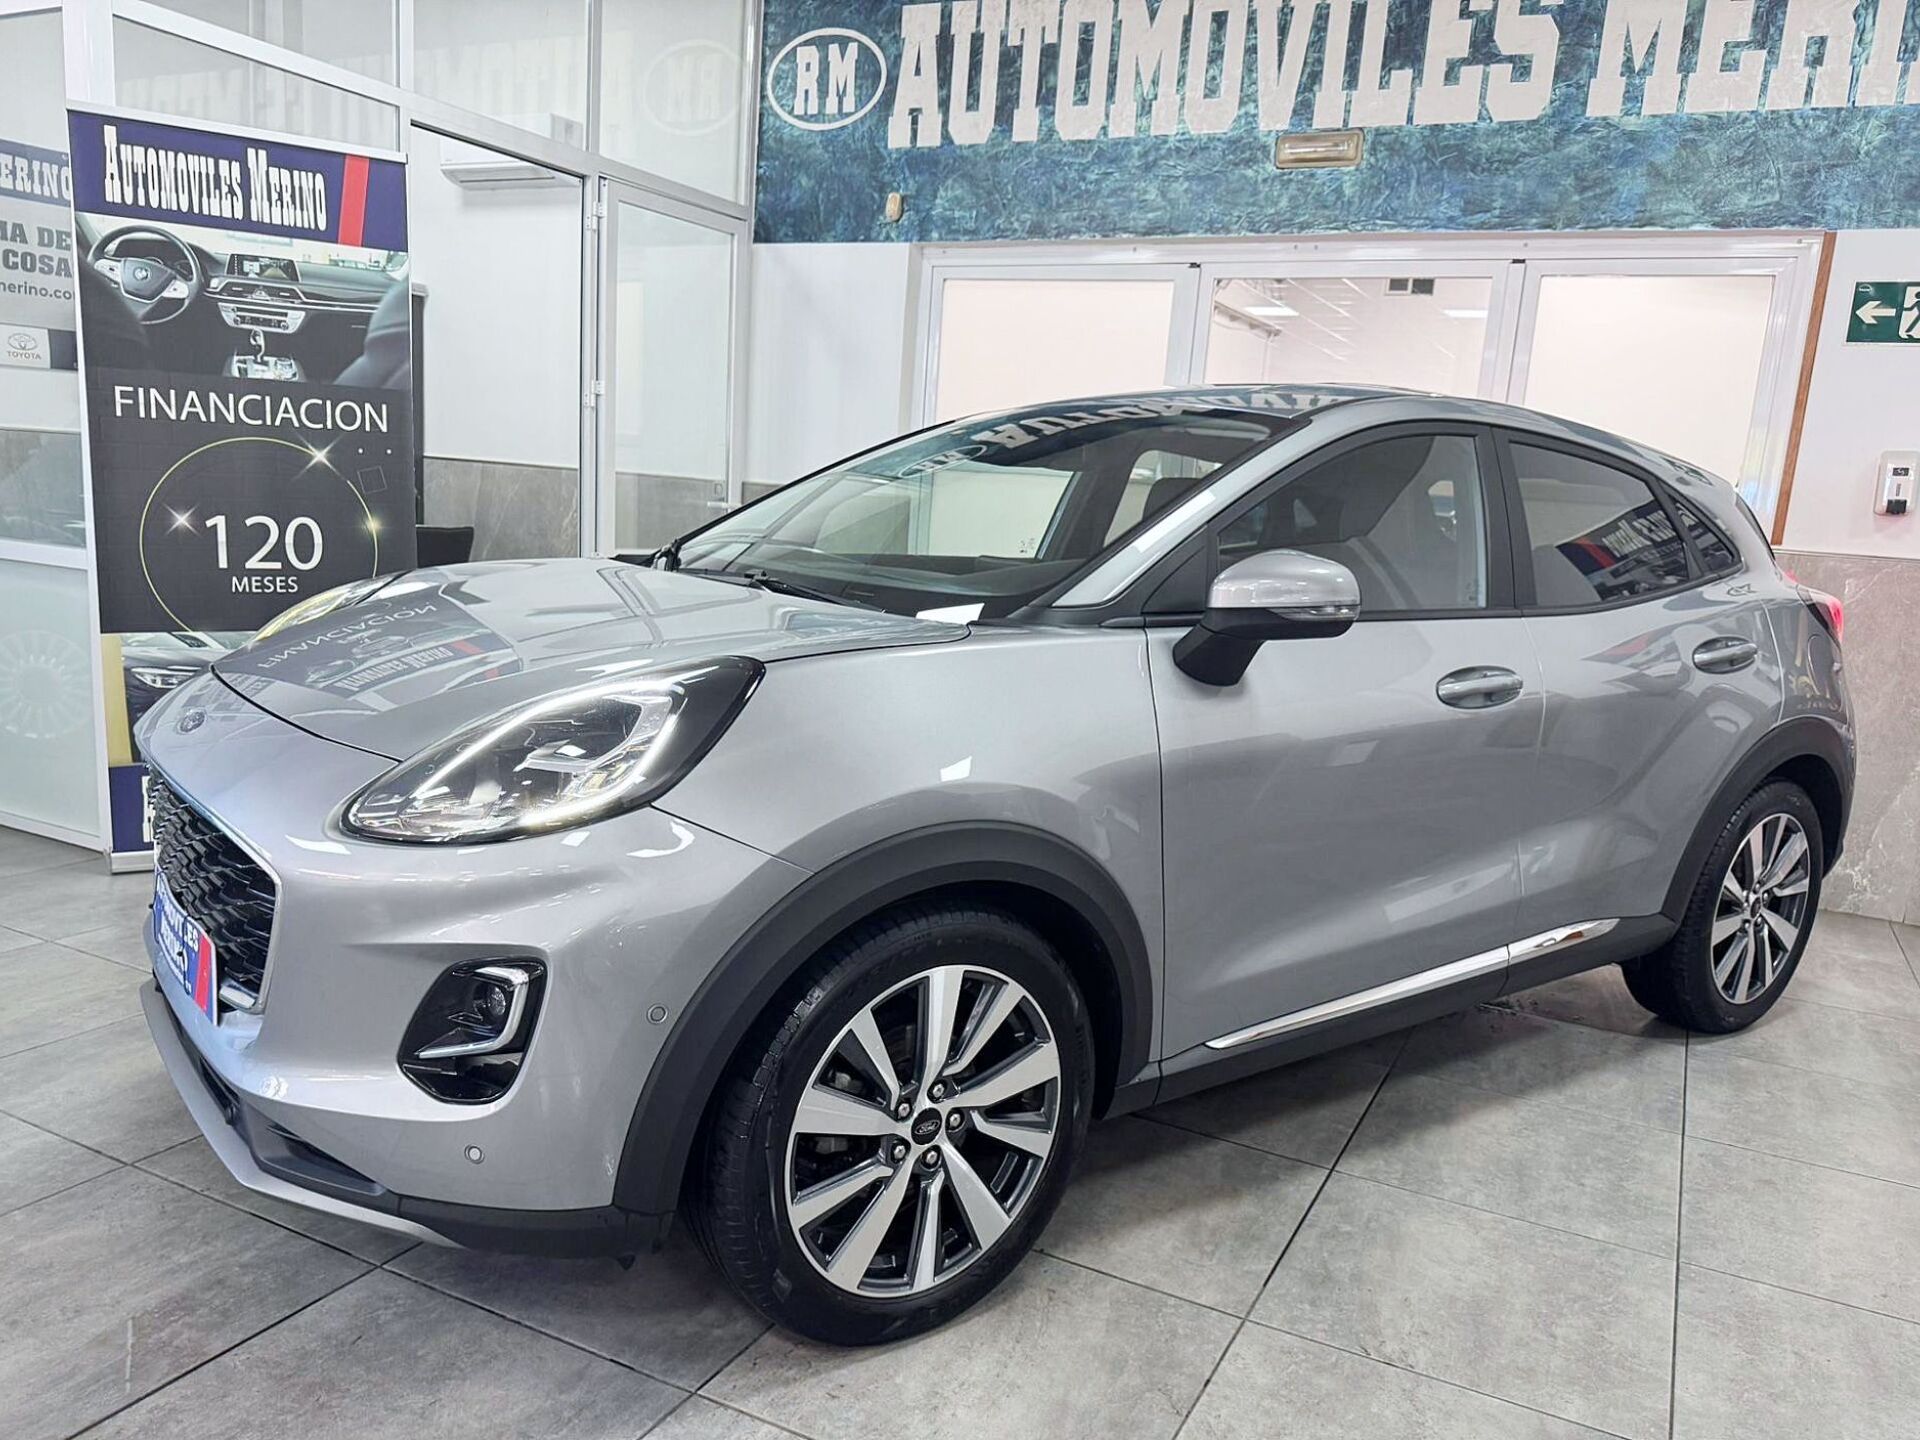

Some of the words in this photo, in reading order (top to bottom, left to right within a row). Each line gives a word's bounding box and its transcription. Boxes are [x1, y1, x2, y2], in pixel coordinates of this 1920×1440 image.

[793, 42, 858, 115] RM
[888, 0, 1560, 147] AUTOMOVILES
[37, 226, 71, 251] DE
[2, 248, 72, 278] COSA
[0, 281, 75, 300] erino.co
[7, 350, 42, 360] TOYOTA
[114, 385, 388, 433] FINANCIACION
[205, 515, 323, 570] 120
[231, 576, 298, 593] MESES
